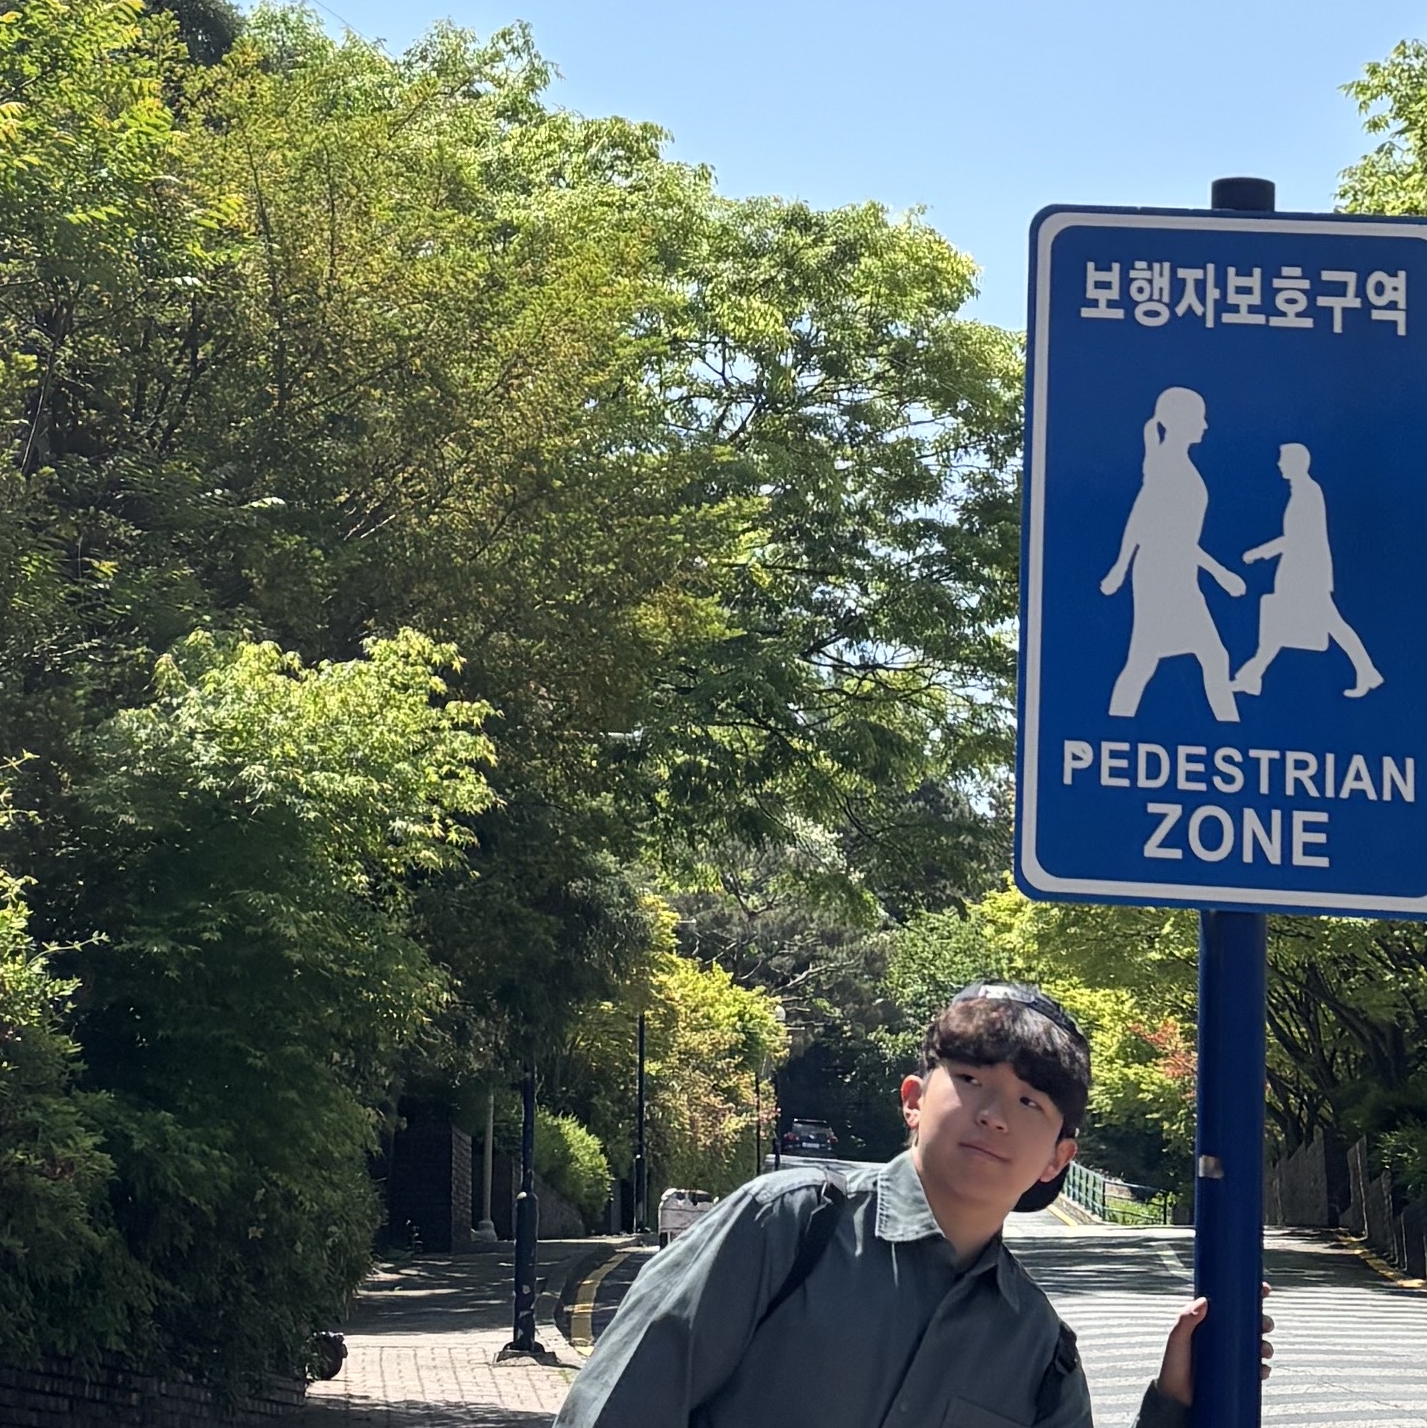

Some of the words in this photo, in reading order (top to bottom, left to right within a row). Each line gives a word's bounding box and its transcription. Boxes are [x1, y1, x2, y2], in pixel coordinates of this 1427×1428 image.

[1080, 261, 1406, 336] 보행자보호구역
[1063, 739, 1415, 803] PEDESTRIAN
[1143, 802, 1330, 868] ZONE
